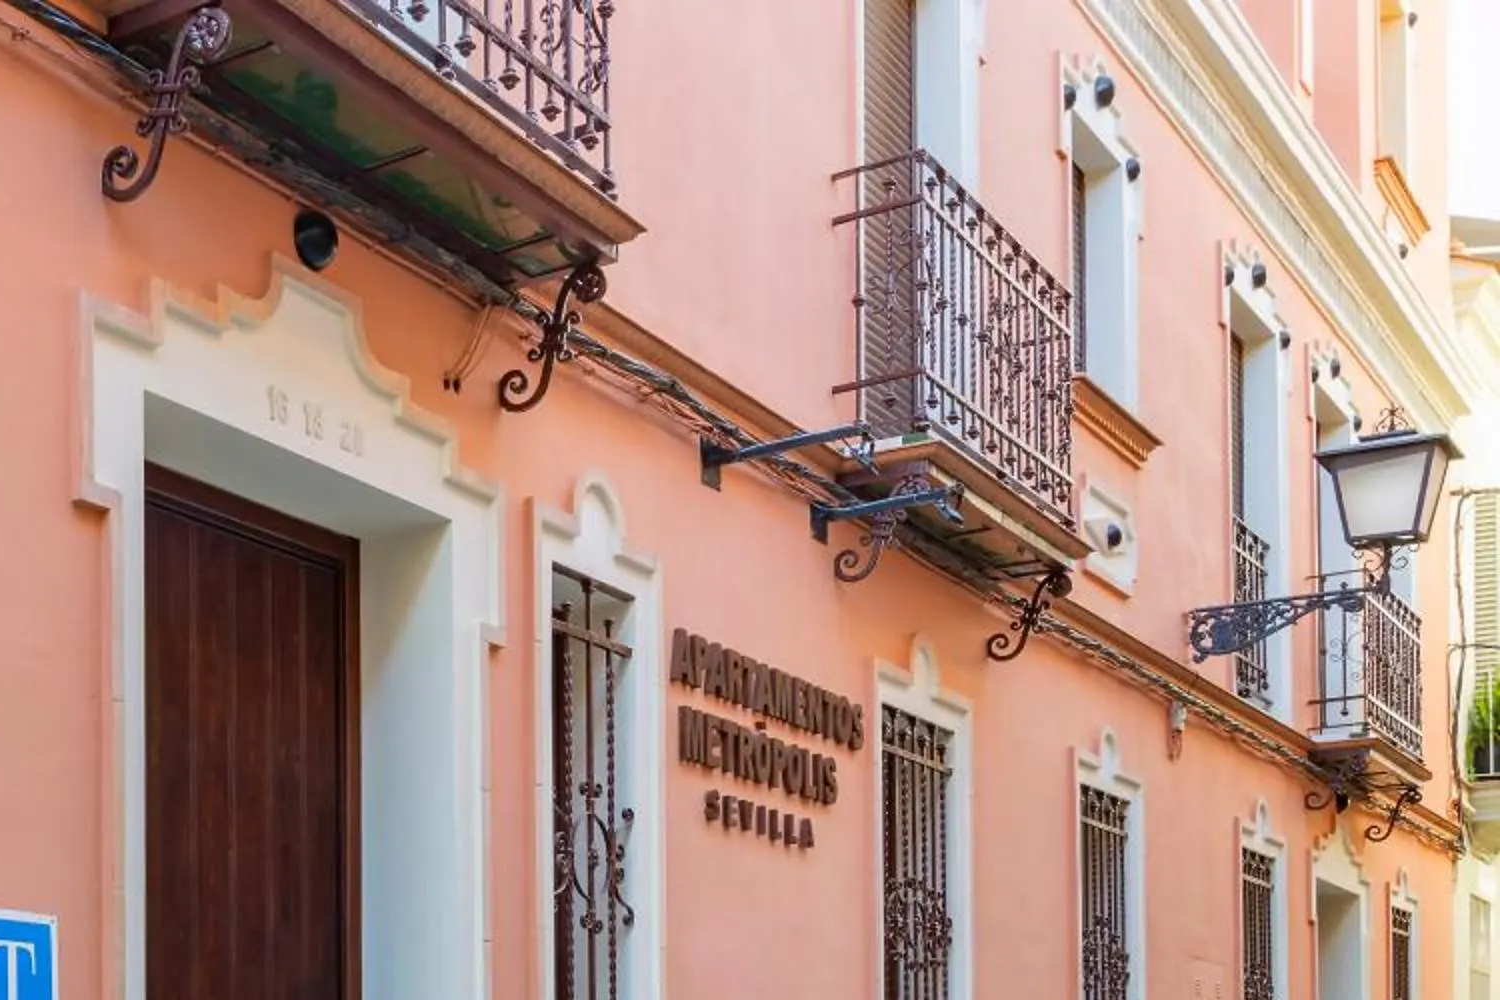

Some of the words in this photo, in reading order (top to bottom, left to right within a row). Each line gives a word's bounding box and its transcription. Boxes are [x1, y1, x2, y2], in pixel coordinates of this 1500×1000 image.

[670, 628, 864, 750] APARTAMENTOS
[678, 705, 838, 805] METRÓPOLIS
[704, 789, 815, 849] SEVILLA
